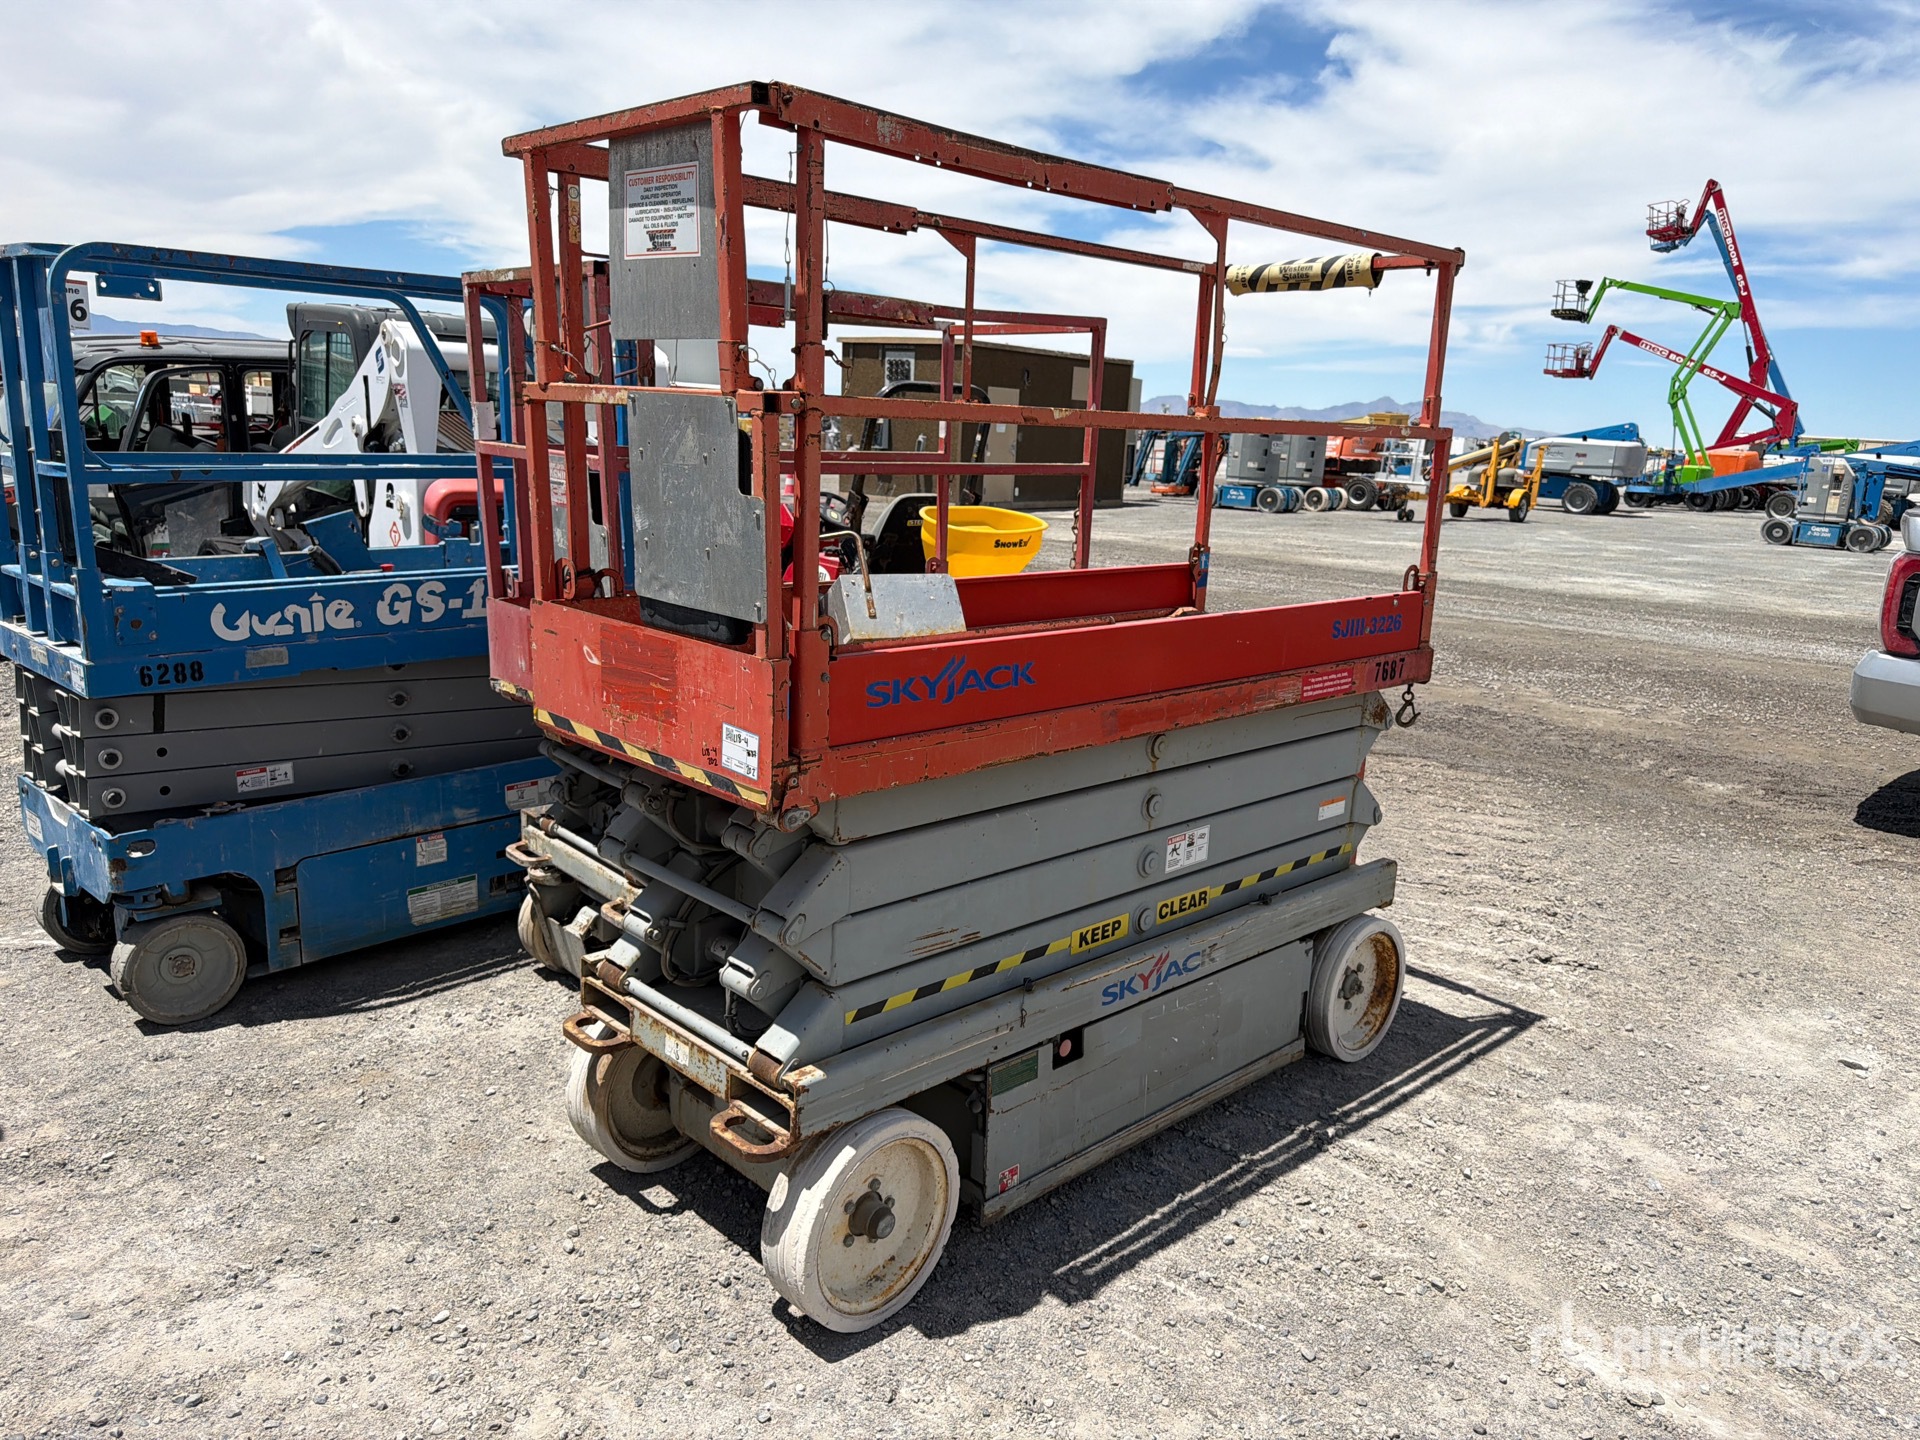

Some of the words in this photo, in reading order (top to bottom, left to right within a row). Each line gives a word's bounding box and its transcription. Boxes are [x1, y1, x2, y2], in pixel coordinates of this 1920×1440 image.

[628, 176, 654, 187] CUSTOMER
[656, 171, 694, 183] RESPONSIBILITY
[649, 199, 668, 207] CLEANING
[671, 197, 694, 205] REFUELING
[663, 205, 687, 213] INSURANCE
[648, 233, 674, 242] Western
[651, 240, 671, 250] States
[1725, 237, 1739, 267] BOOM
[1279, 265, 1313, 275] Western
[1282, 273, 1309, 282] States
[70, 298, 88, 321] 6
[1639, 341, 1669, 357] mec
[1703, 368, 1727, 381] 65-J
[210, 592, 356, 641] Genie
[1369, 614, 1403, 635] 3226
[139, 660, 204, 687] 6288
[1375, 657, 1406, 682] 7687
[866, 655, 1036, 708] SKYJACK
[1078, 920, 1122, 948] KEEP
[1158, 890, 1208, 920] CLEAR
